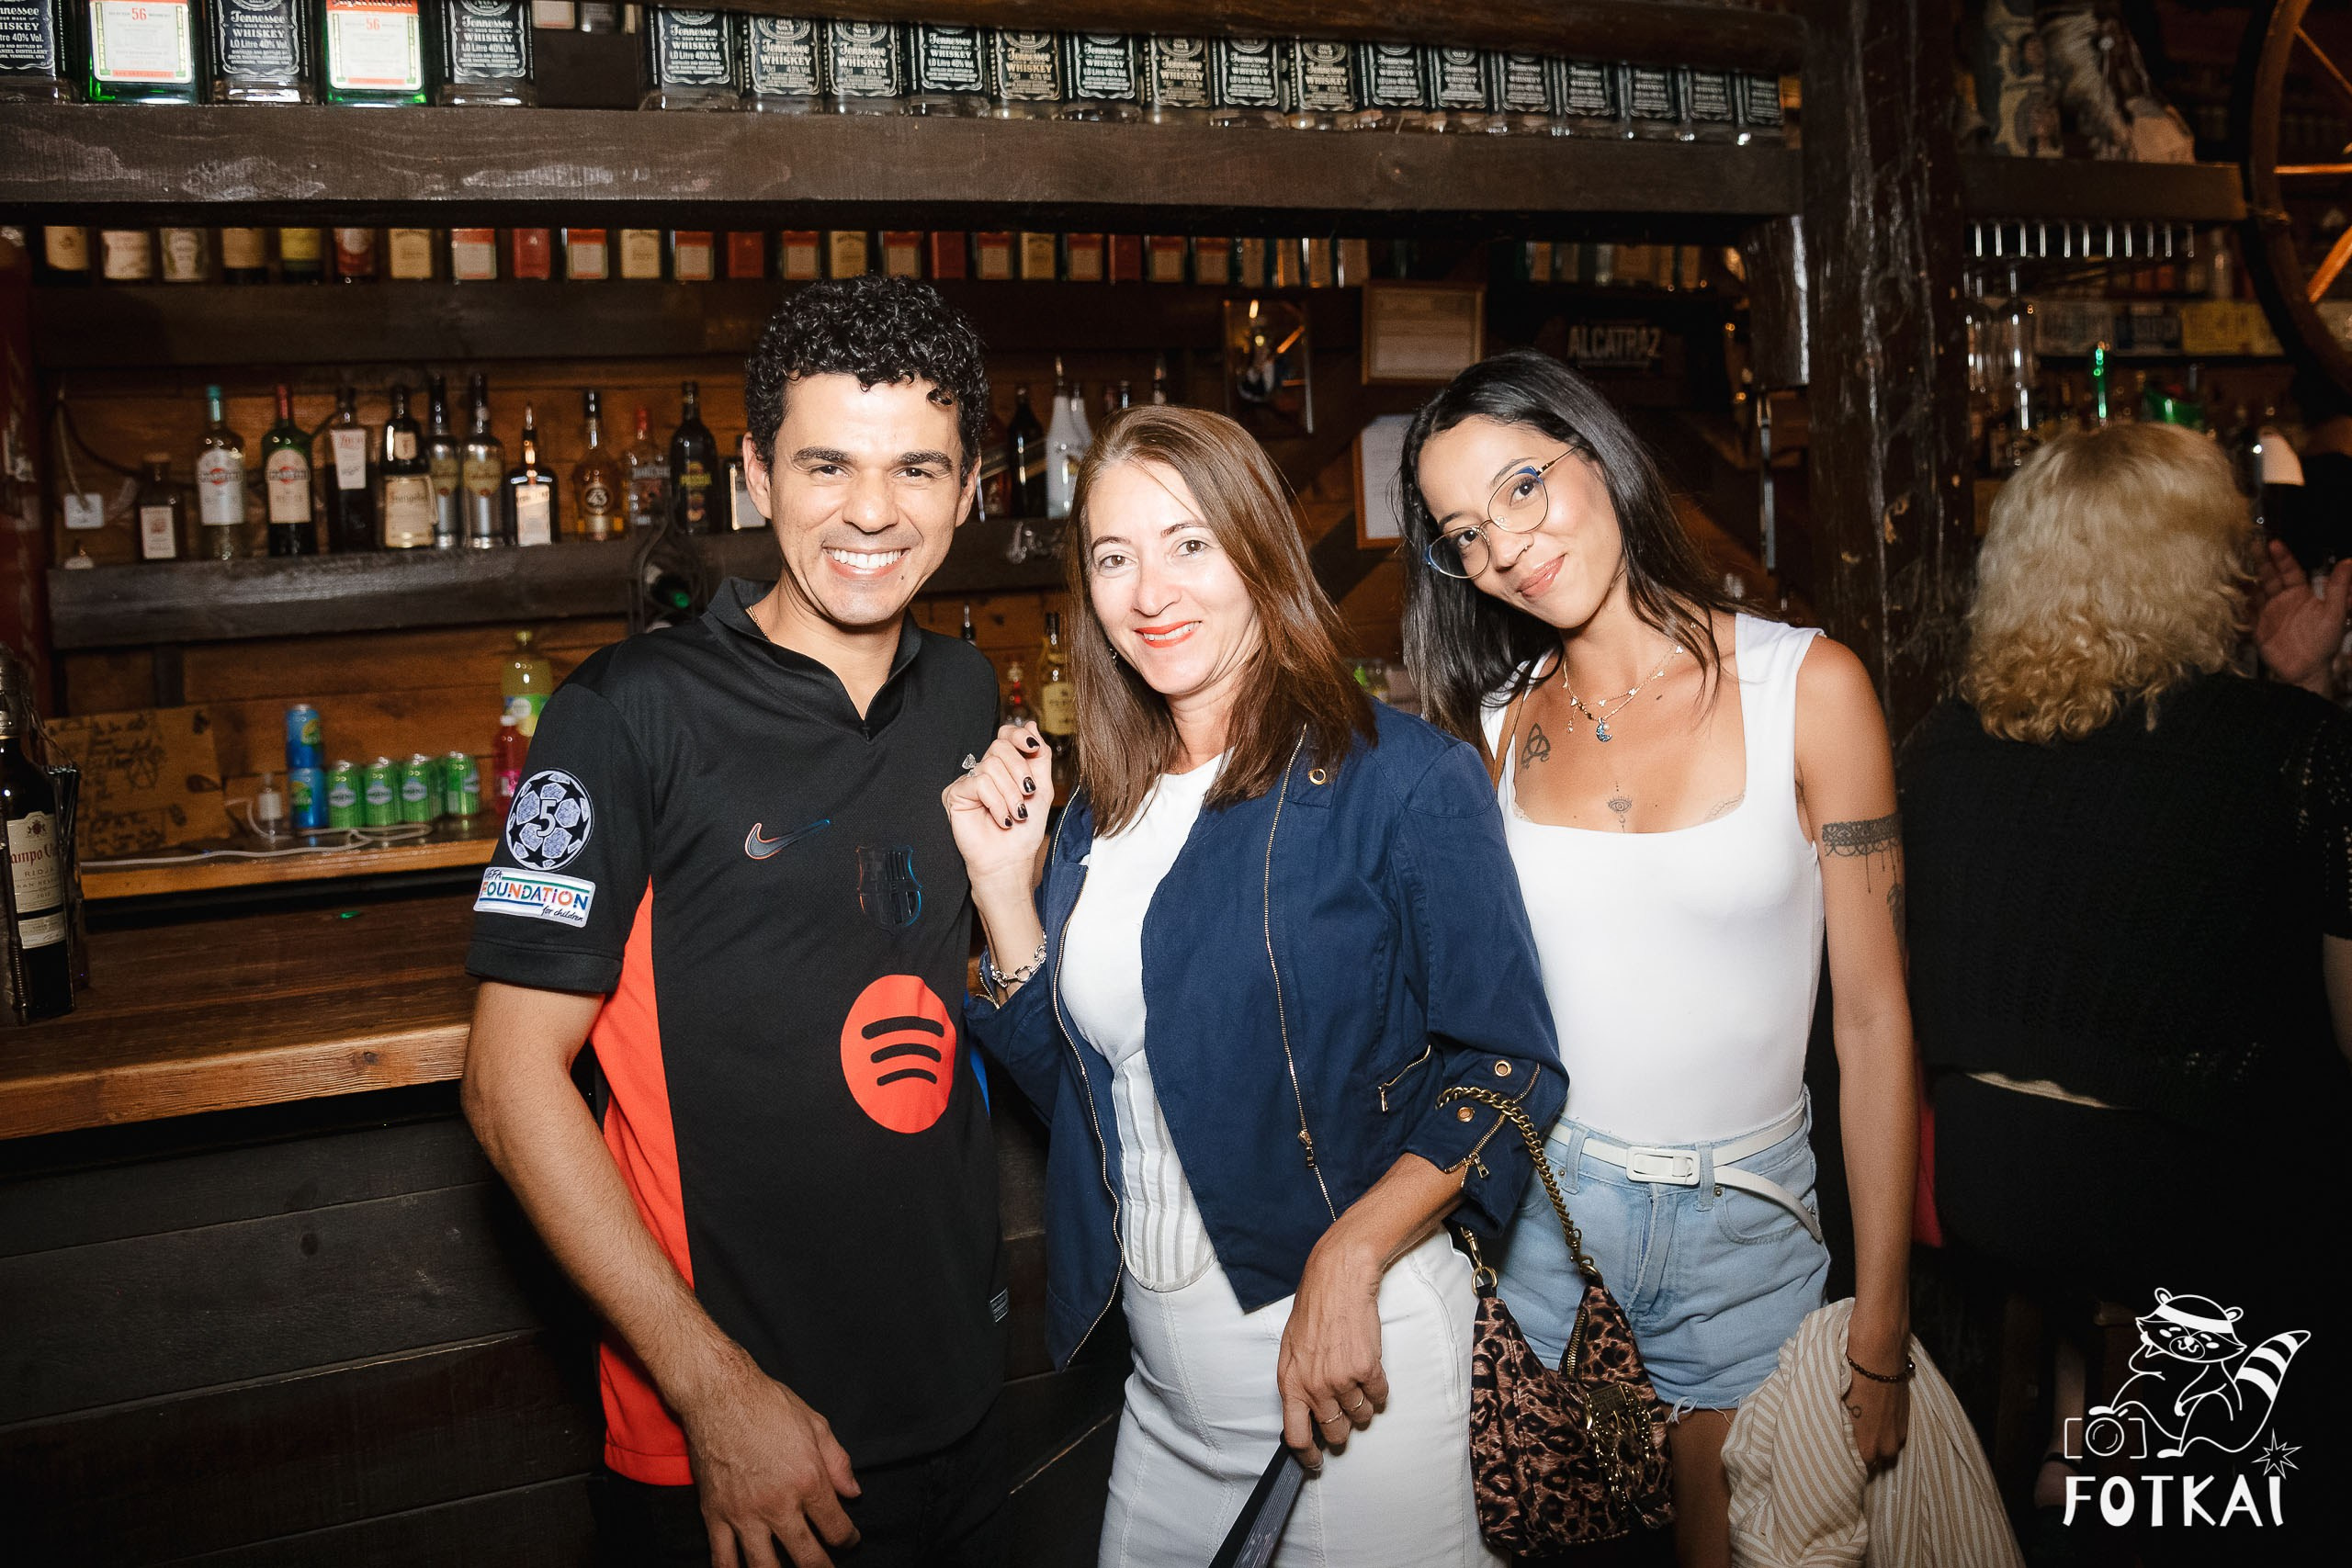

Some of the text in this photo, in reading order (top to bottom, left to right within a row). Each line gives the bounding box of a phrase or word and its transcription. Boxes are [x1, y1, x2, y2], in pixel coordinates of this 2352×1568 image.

[131, 7, 147, 20] 56
[230, 10, 288, 24] Tennessee
[366, 17, 380, 30] 56
[461, 15, 514, 28] Tennessee
[232, 28, 286, 39] WHISKEY
[462, 32, 514, 42] WHISKEY
[670, 24, 718, 37] Tennessee
[12, 33, 28, 42] 40%
[29, 33, 44, 42] Vol.
[240, 39, 258, 49] Litre
[258, 39, 276, 49] 40%
[671, 41, 718, 51] WHISKEY
[762, 38, 810, 54] Tennessee
[760, 54, 812, 65] WHISKEY
[930, 49, 972, 59] WHISKEY
[837, 57, 888, 69] WHISKEY
[1006, 62, 1052, 73] WHISKEY
[1159, 70, 1204, 81] WHISKEY
[1566, 324, 1663, 358] ALCATRAZ
[537, 798, 558, 838] 5
[11, 849, 42, 866] ampo
[481, 881, 589, 910] FOUNDATION
[541, 905, 584, 922] for children
